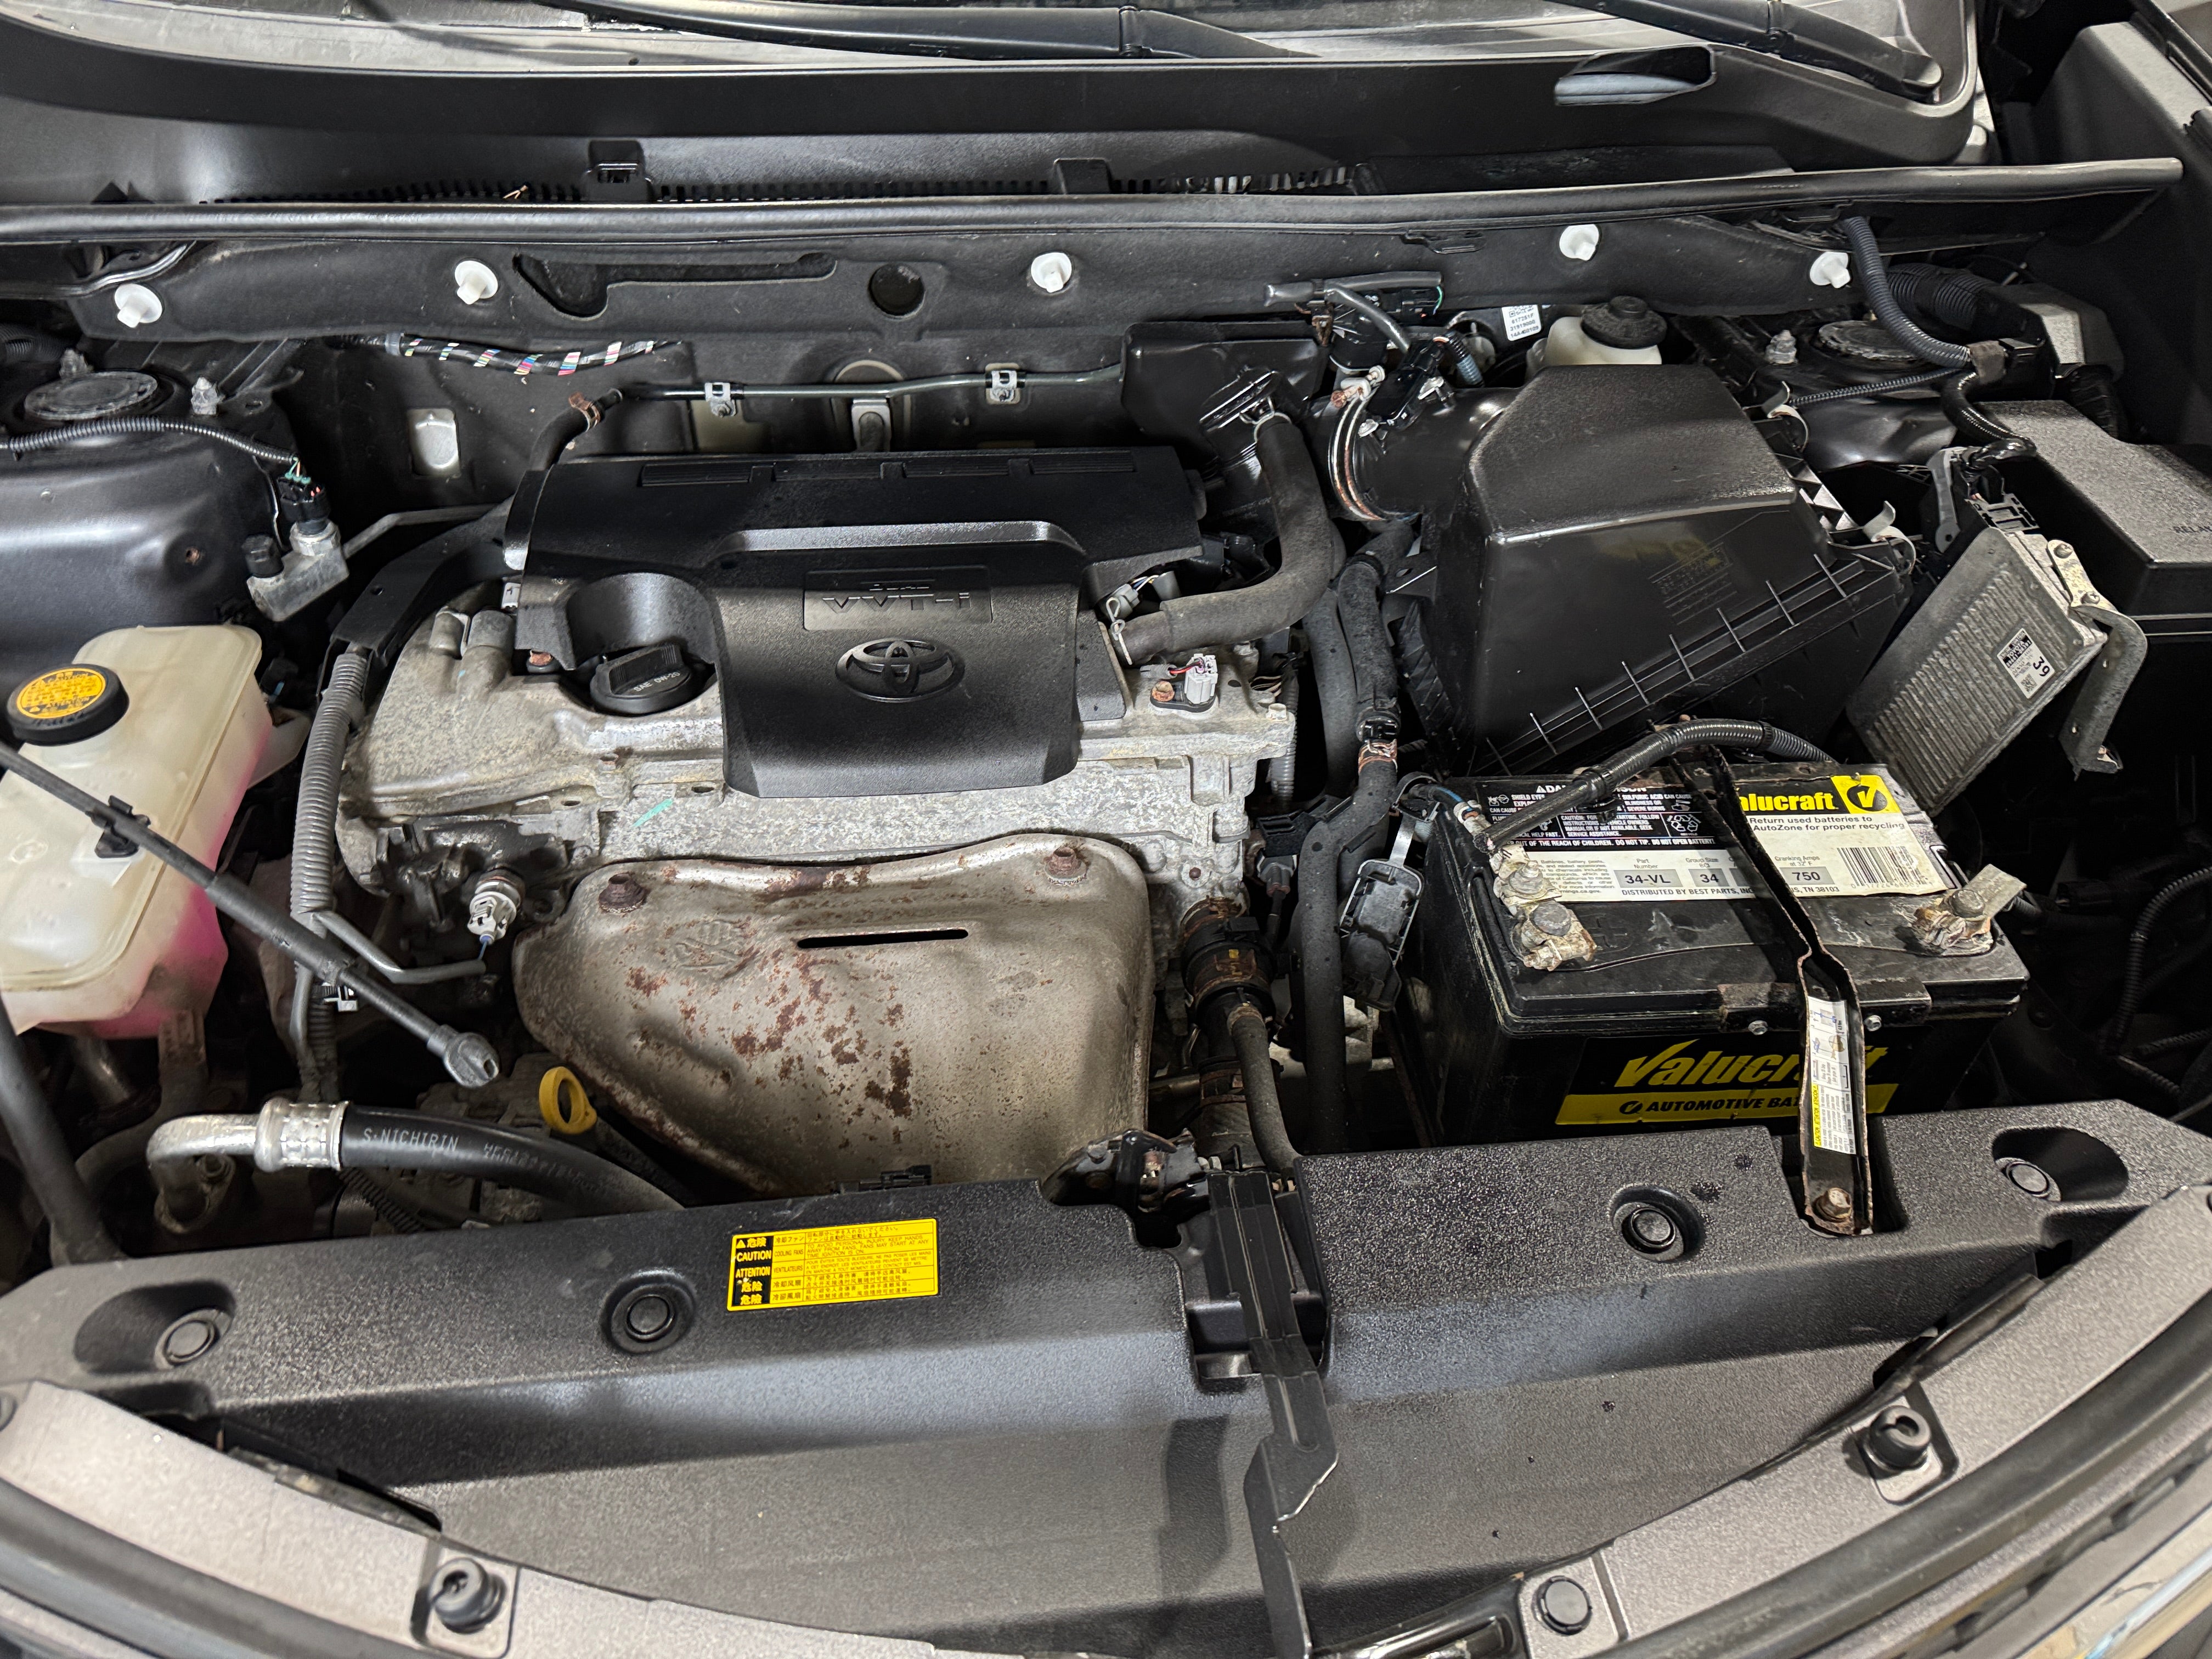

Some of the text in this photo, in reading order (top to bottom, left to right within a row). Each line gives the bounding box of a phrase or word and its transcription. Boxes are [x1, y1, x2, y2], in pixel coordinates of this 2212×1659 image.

[2033, 656, 2051, 677] 39
[634, 681, 653, 692] SAE
[1823, 823, 1856, 832] proper
[1859, 822, 1905, 830] recycling
[1624, 871, 1821, 884] 34-VL 34 750
[1646, 1096, 1765, 1112] AUTOMOTIVE
[736, 1250, 772, 1262] CAUTION
[735, 1266, 771, 1278] ATTENTION
